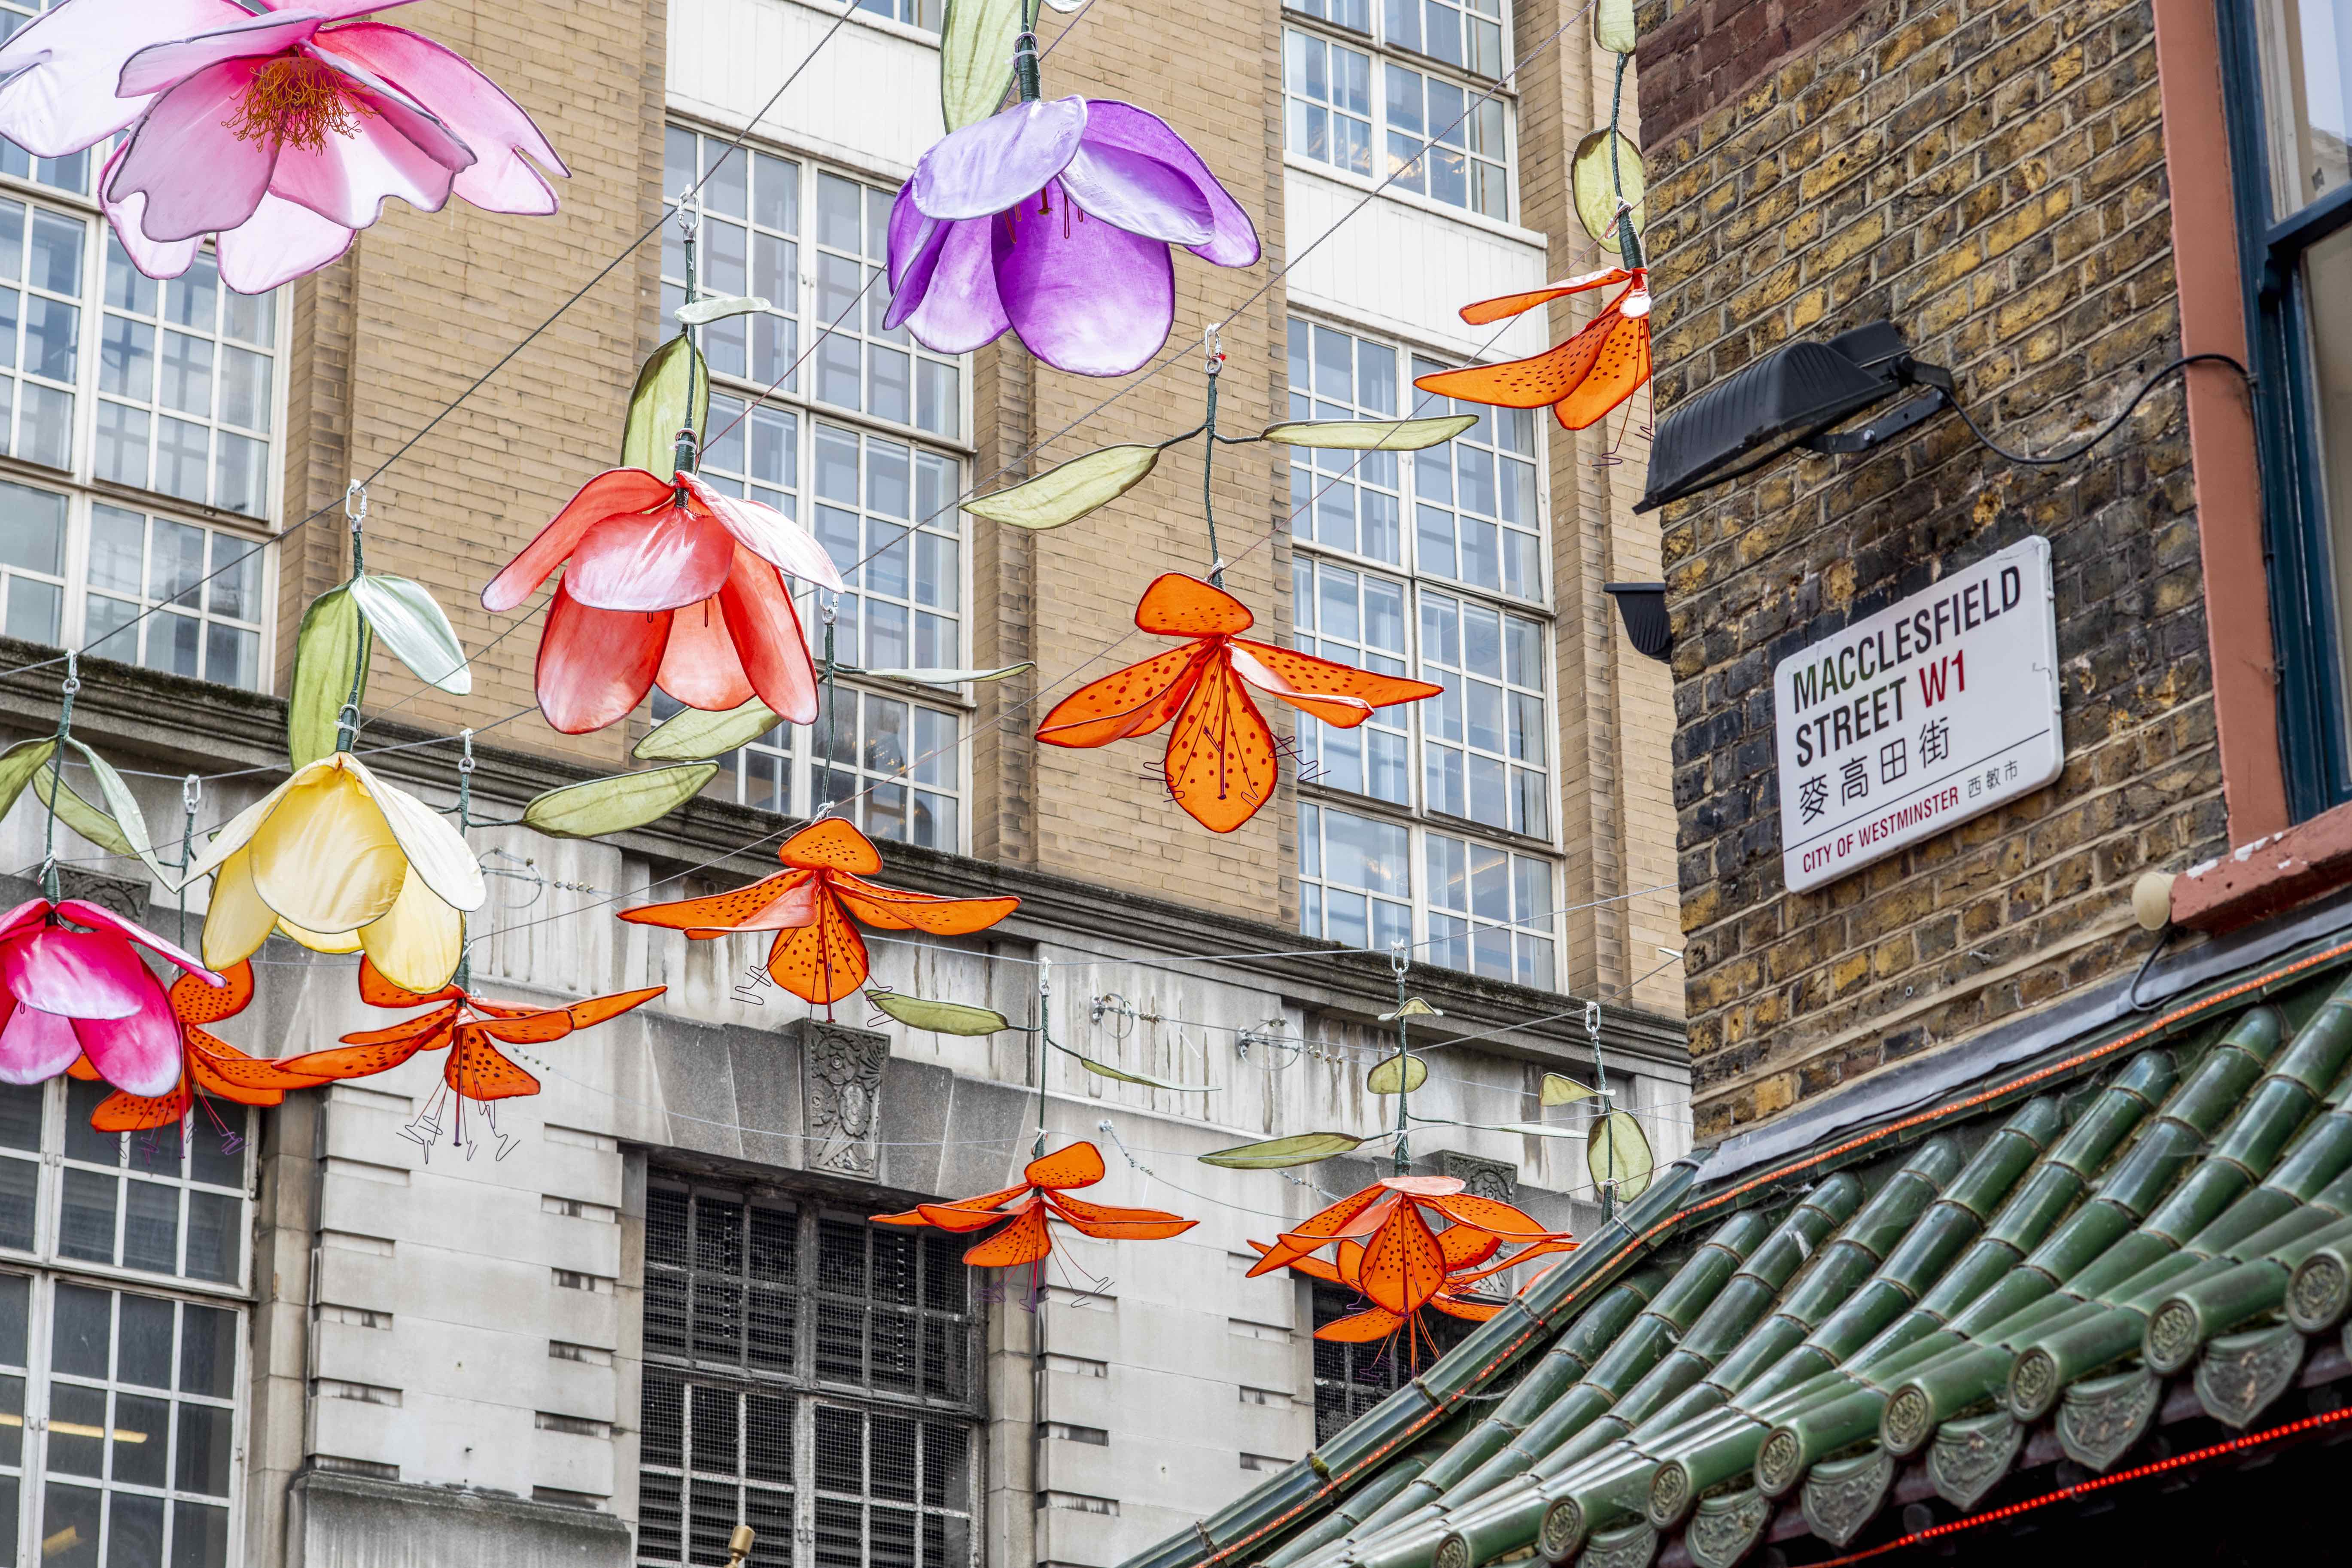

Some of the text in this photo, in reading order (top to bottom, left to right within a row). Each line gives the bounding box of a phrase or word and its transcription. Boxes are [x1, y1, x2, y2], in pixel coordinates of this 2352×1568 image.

[1793, 566, 2021, 715] MACCLESFIELD
[1795, 649, 1965, 768] STREET W1
[1803, 760, 2018, 873] CITY OF WESTMINSTER 西敏市
